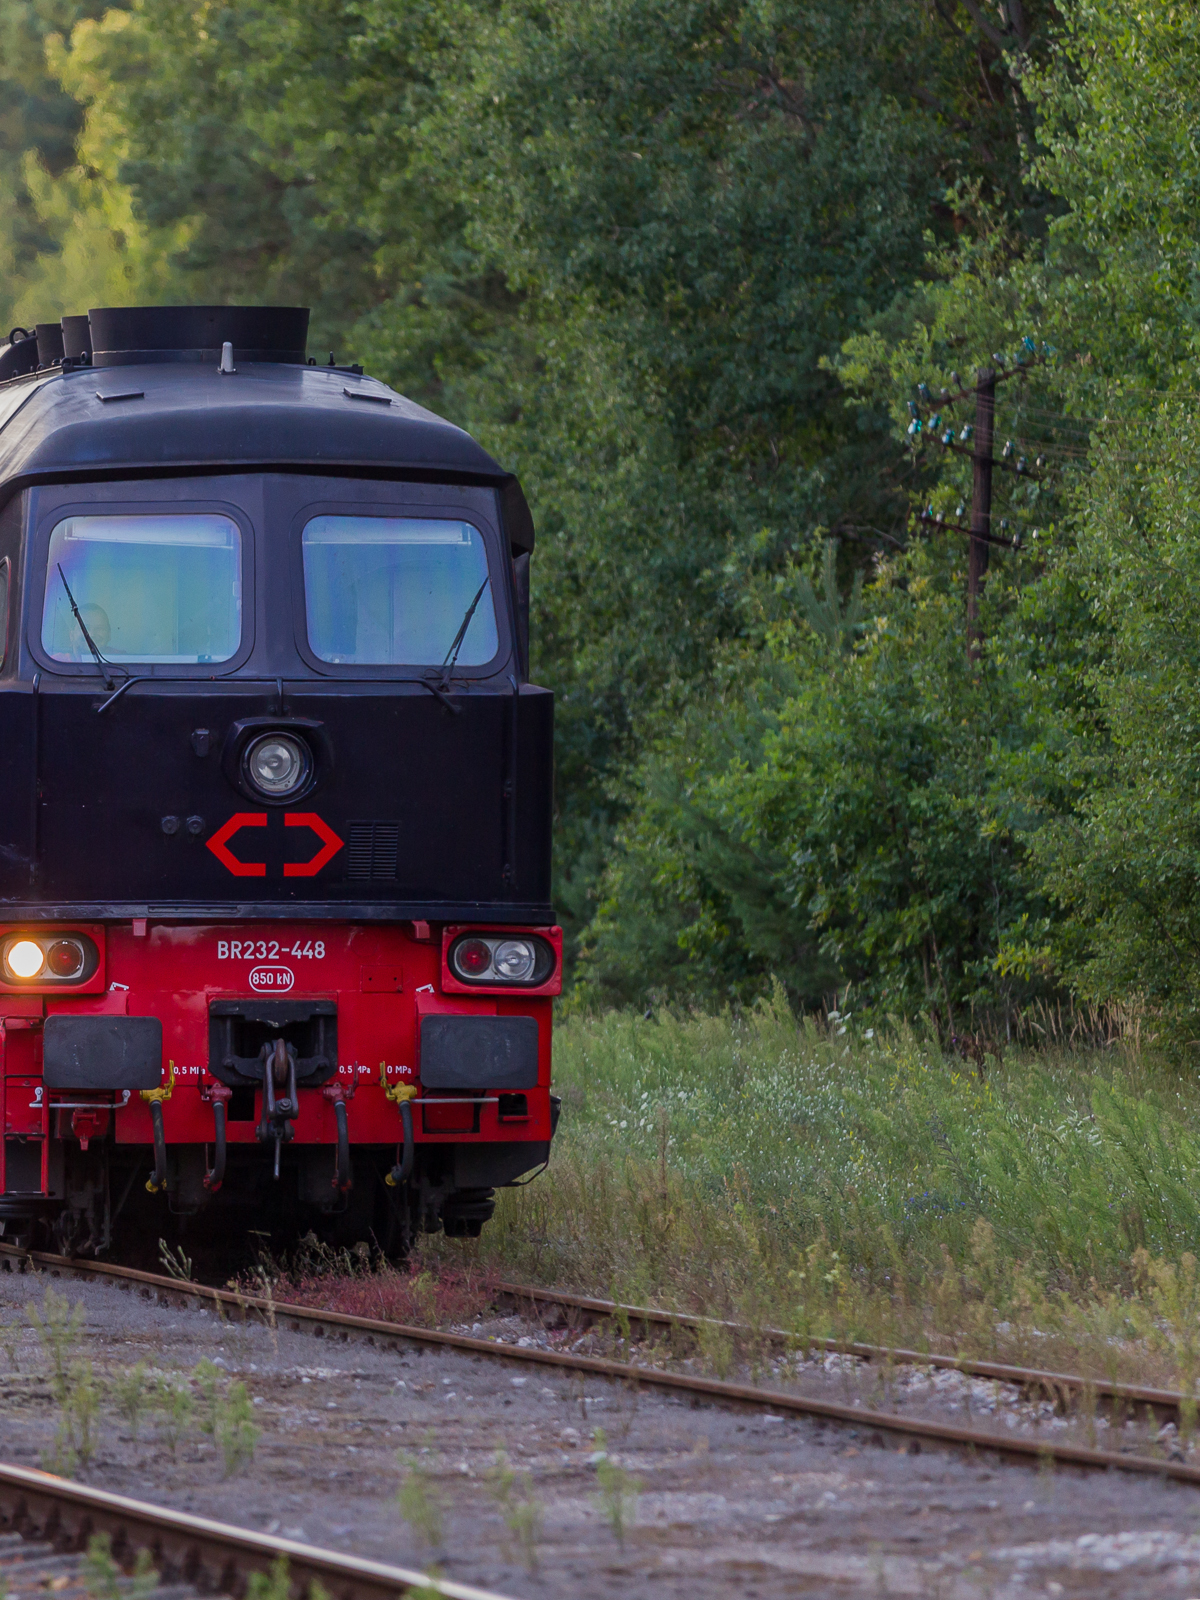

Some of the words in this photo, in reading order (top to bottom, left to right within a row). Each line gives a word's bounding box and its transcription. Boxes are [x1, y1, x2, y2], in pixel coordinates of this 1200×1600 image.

[217, 940, 326, 960] BR232-448
[252, 972, 274, 986] 850
[276, 972, 291, 986] kN
[395, 1065, 412, 1075] MPa
